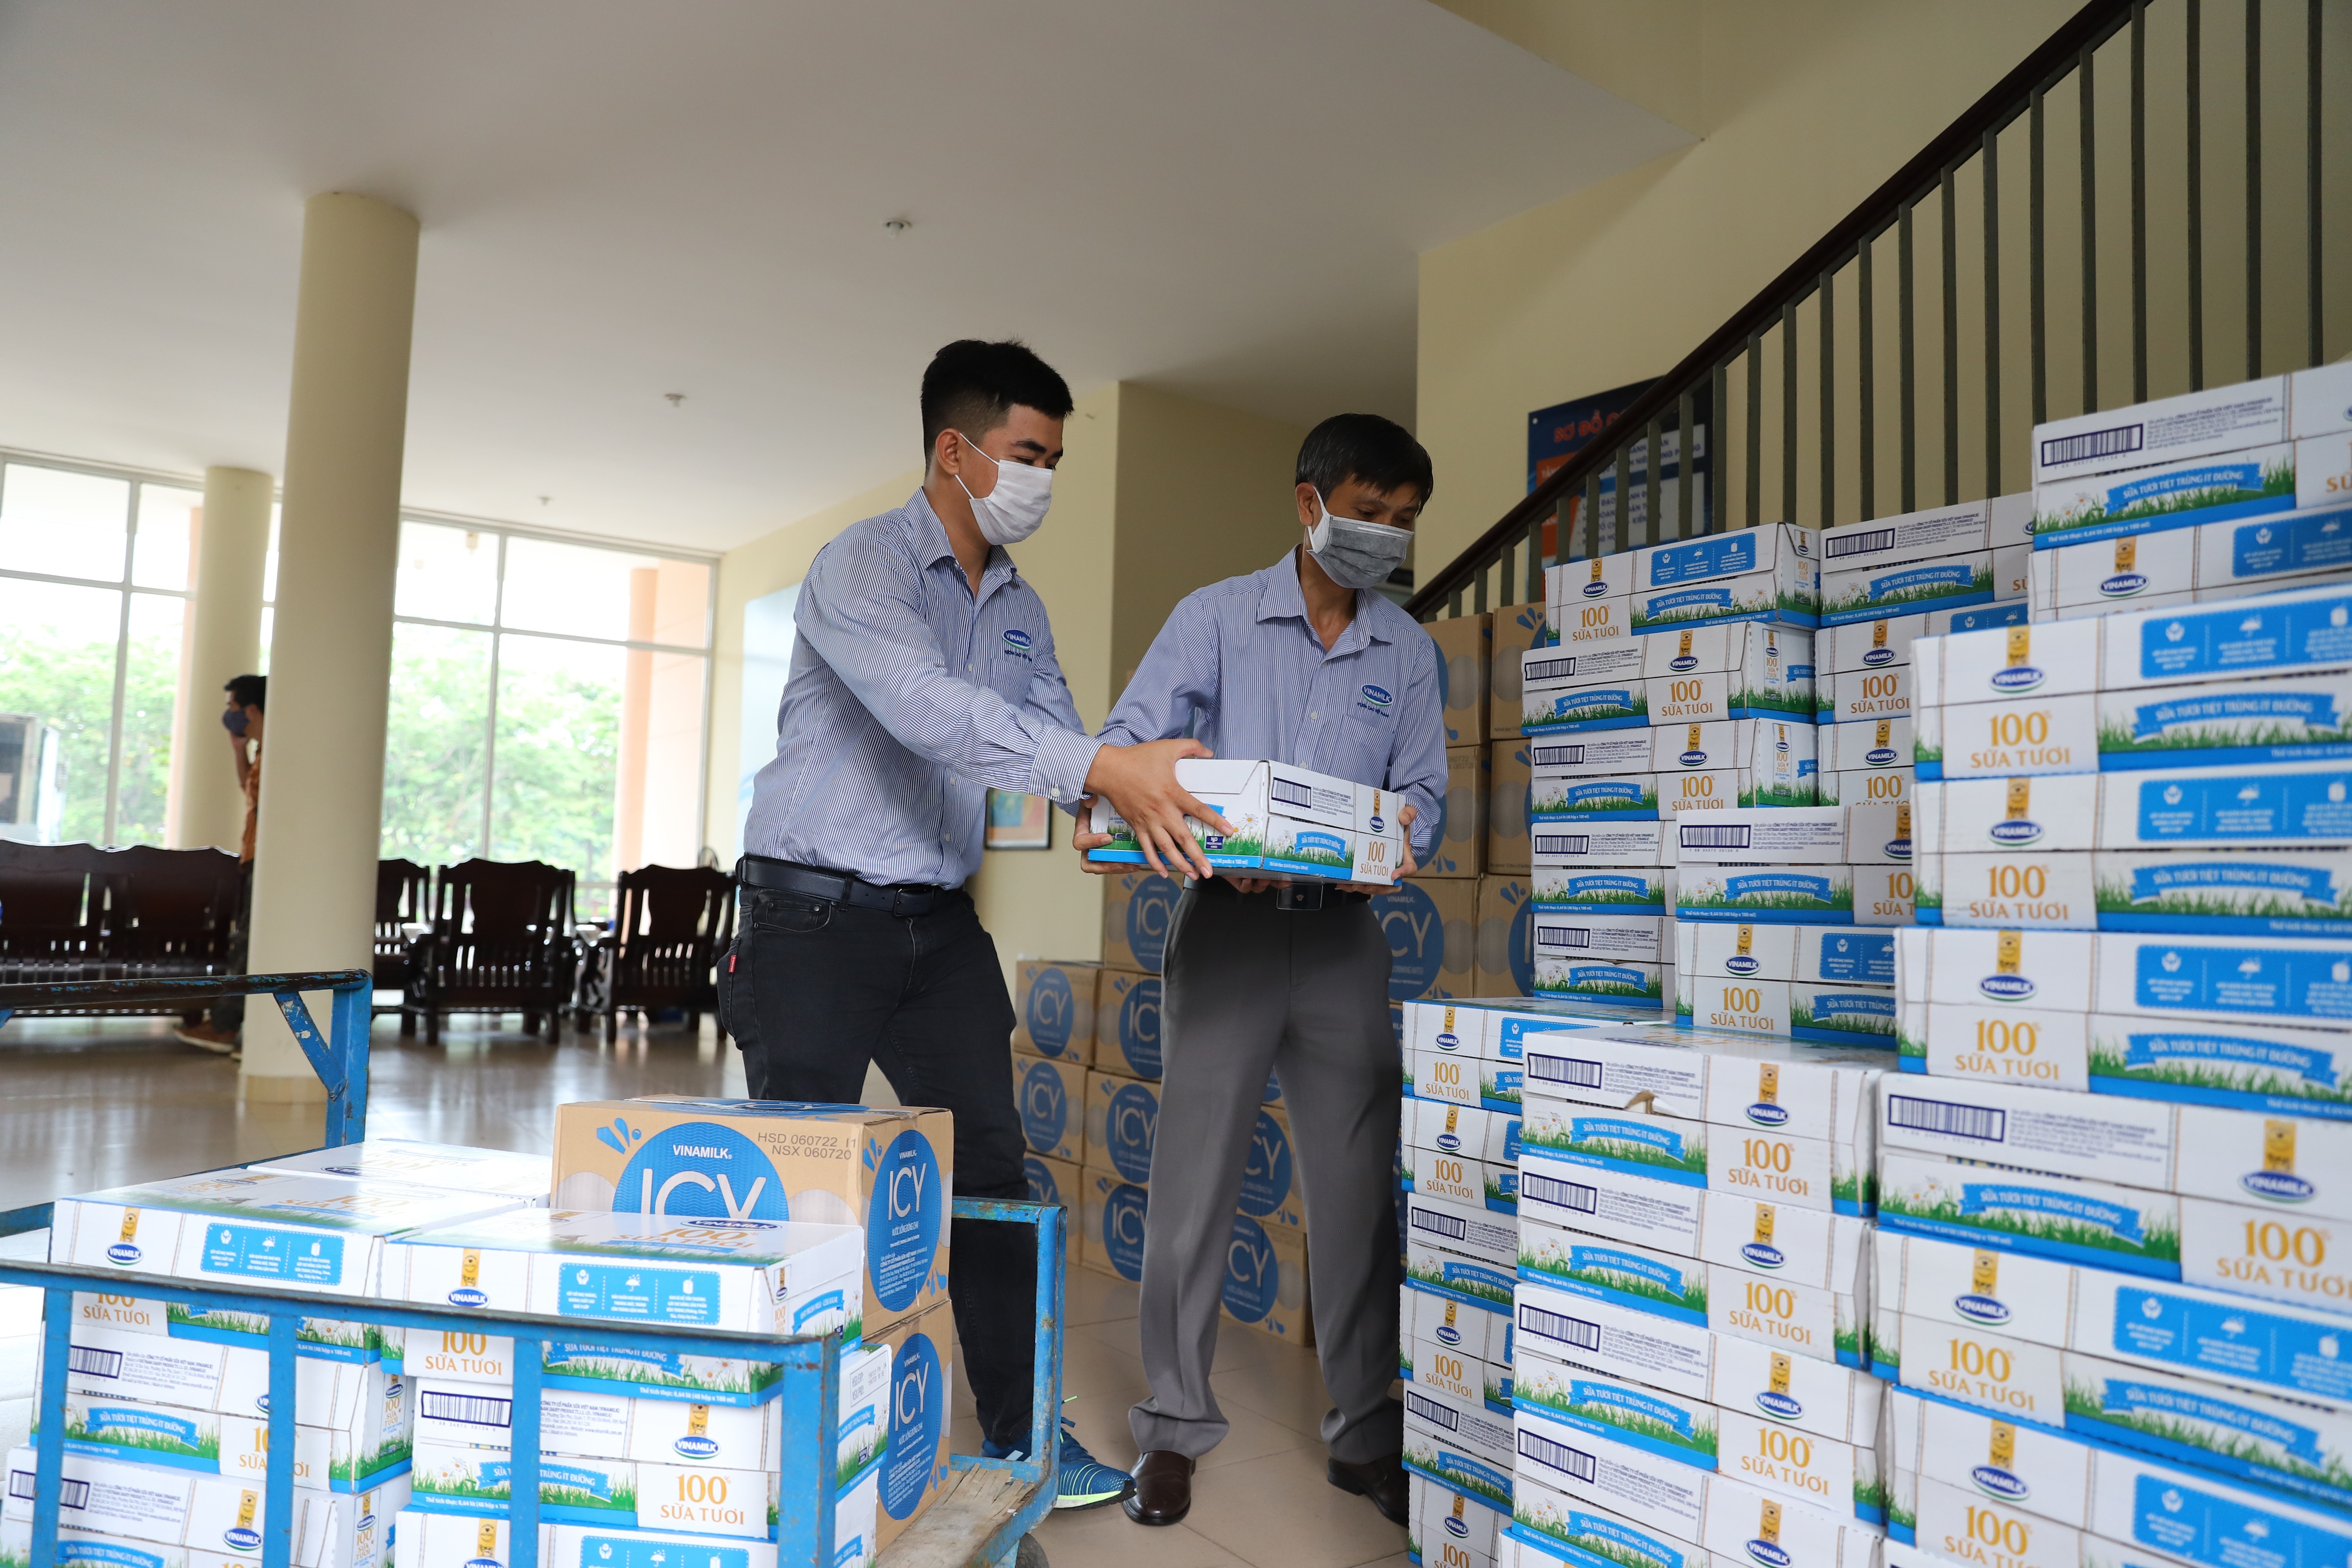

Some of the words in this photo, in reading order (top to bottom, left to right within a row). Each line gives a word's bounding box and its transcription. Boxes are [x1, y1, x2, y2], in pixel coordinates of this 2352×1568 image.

[1584, 584, 1606, 593] VINAMILK
[1881, 580, 1891, 589] SỮA
[1891, 577, 1904, 586] TƯƠI
[2102, 577, 2146, 590] VINAMILK
[1005, 632, 1031, 645] VINAMILK
[1573, 629, 1592, 641] SỮA
[1594, 626, 1619, 638] TƯƠI
[1865, 652, 1893, 661] VINAMILK
[1997, 671, 2037, 684] VINAMILK
[1364, 686, 1391, 702] VINAMILK
[1662, 704, 1683, 716] SỮA
[1685, 703, 1713, 714] TƯƠI
[1851, 700, 1874, 714] SỮA
[1878, 698, 1909, 710] TƯƠI
[1672, 800, 1692, 811] SỮA
[1696, 799, 1724, 809] TƯƠI
[1995, 826, 2035, 836] VINAMILK
[1360, 862, 1372, 875] SỮA
[1374, 865, 1389, 876] TƯƠI
[1727, 960, 1757, 969] VINAMILK
[1982, 980, 2028, 993] VINAMILK
[1034, 988, 1068, 1026] ICY
[1711, 1012, 1736, 1027] SỮA
[1740, 1015, 1774, 1030] TƯƠI
[1437, 1036, 1457, 1045] VINAMILK
[1427, 1084, 1443, 1095] SỮA
[1447, 1086, 1469, 1099] TƯƠI
[1027, 1082, 1061, 1121] ICY
[1748, 1107, 1786, 1120] VINAMILK
[1115, 1104, 1157, 1150] ICY
[757, 1132, 787, 1144] HSD
[791, 1135, 838, 1147] 060722
[1438, 1137, 1459, 1146] VINAMILK
[673, 1145, 729, 1159] VINAMILK
[771, 1145, 800, 1156] NSX
[804, 1147, 852, 1160] 060720
[899, 1149, 917, 1159] VINAMILK
[1730, 1167, 1759, 1187] SỮA
[1765, 1174, 1807, 1195] TƯƠI
[2245, 1175, 2313, 1196] VINAMILK
[641, 1168, 767, 1219] ICY
[888, 1162, 926, 1221] ICY
[1427, 1179, 1446, 1193] SỮA
[1448, 1184, 1473, 1199] TƯƠI
[108, 1248, 139, 1258] VINAMILK
[1743, 1246, 1784, 1263] VINAMILK
[450, 1293, 487, 1304] VINAMILK
[84, 1305, 110, 1320] SỮA
[115, 1309, 149, 1325] TƯƠI
[1956, 1298, 2009, 1317] VINAMILK
[1730, 1308, 1761, 1331] SỮA
[1768, 1319, 1810, 1344] TƯƠI
[1437, 1329, 1459, 1340] VINAMILK
[426, 1354, 456, 1371] SỮA
[462, 1359, 501, 1375] TƯƠI
[904, 1353, 920, 1367] VINAMILK
[1426, 1371, 1444, 1388] SỮA
[1448, 1380, 1472, 1398] TƯƠI
[895, 1361, 929, 1431] ICY
[1583, 1385, 1595, 1396] SỮA
[1596, 1390, 1611, 1400] TƯƠI
[1625, 1395, 1646, 1409] TRÙNG
[1758, 1394, 1801, 1413] VINAMILK
[676, 1440, 718, 1452] VINAMILK
[1742, 1453, 1775, 1479] SỮA
[1782, 1467, 1828, 1495] TƯƠI
[1973, 1469, 2026, 1493] VINAMILK
[662, 1504, 693, 1520] SỮA
[702, 1508, 743, 1524] TƯƠI
[1445, 1518, 1467, 1533] VINAMILK
[227, 1531, 260, 1544] VINAMILK
[1748, 1542, 1790, 1565] VINAMILK
